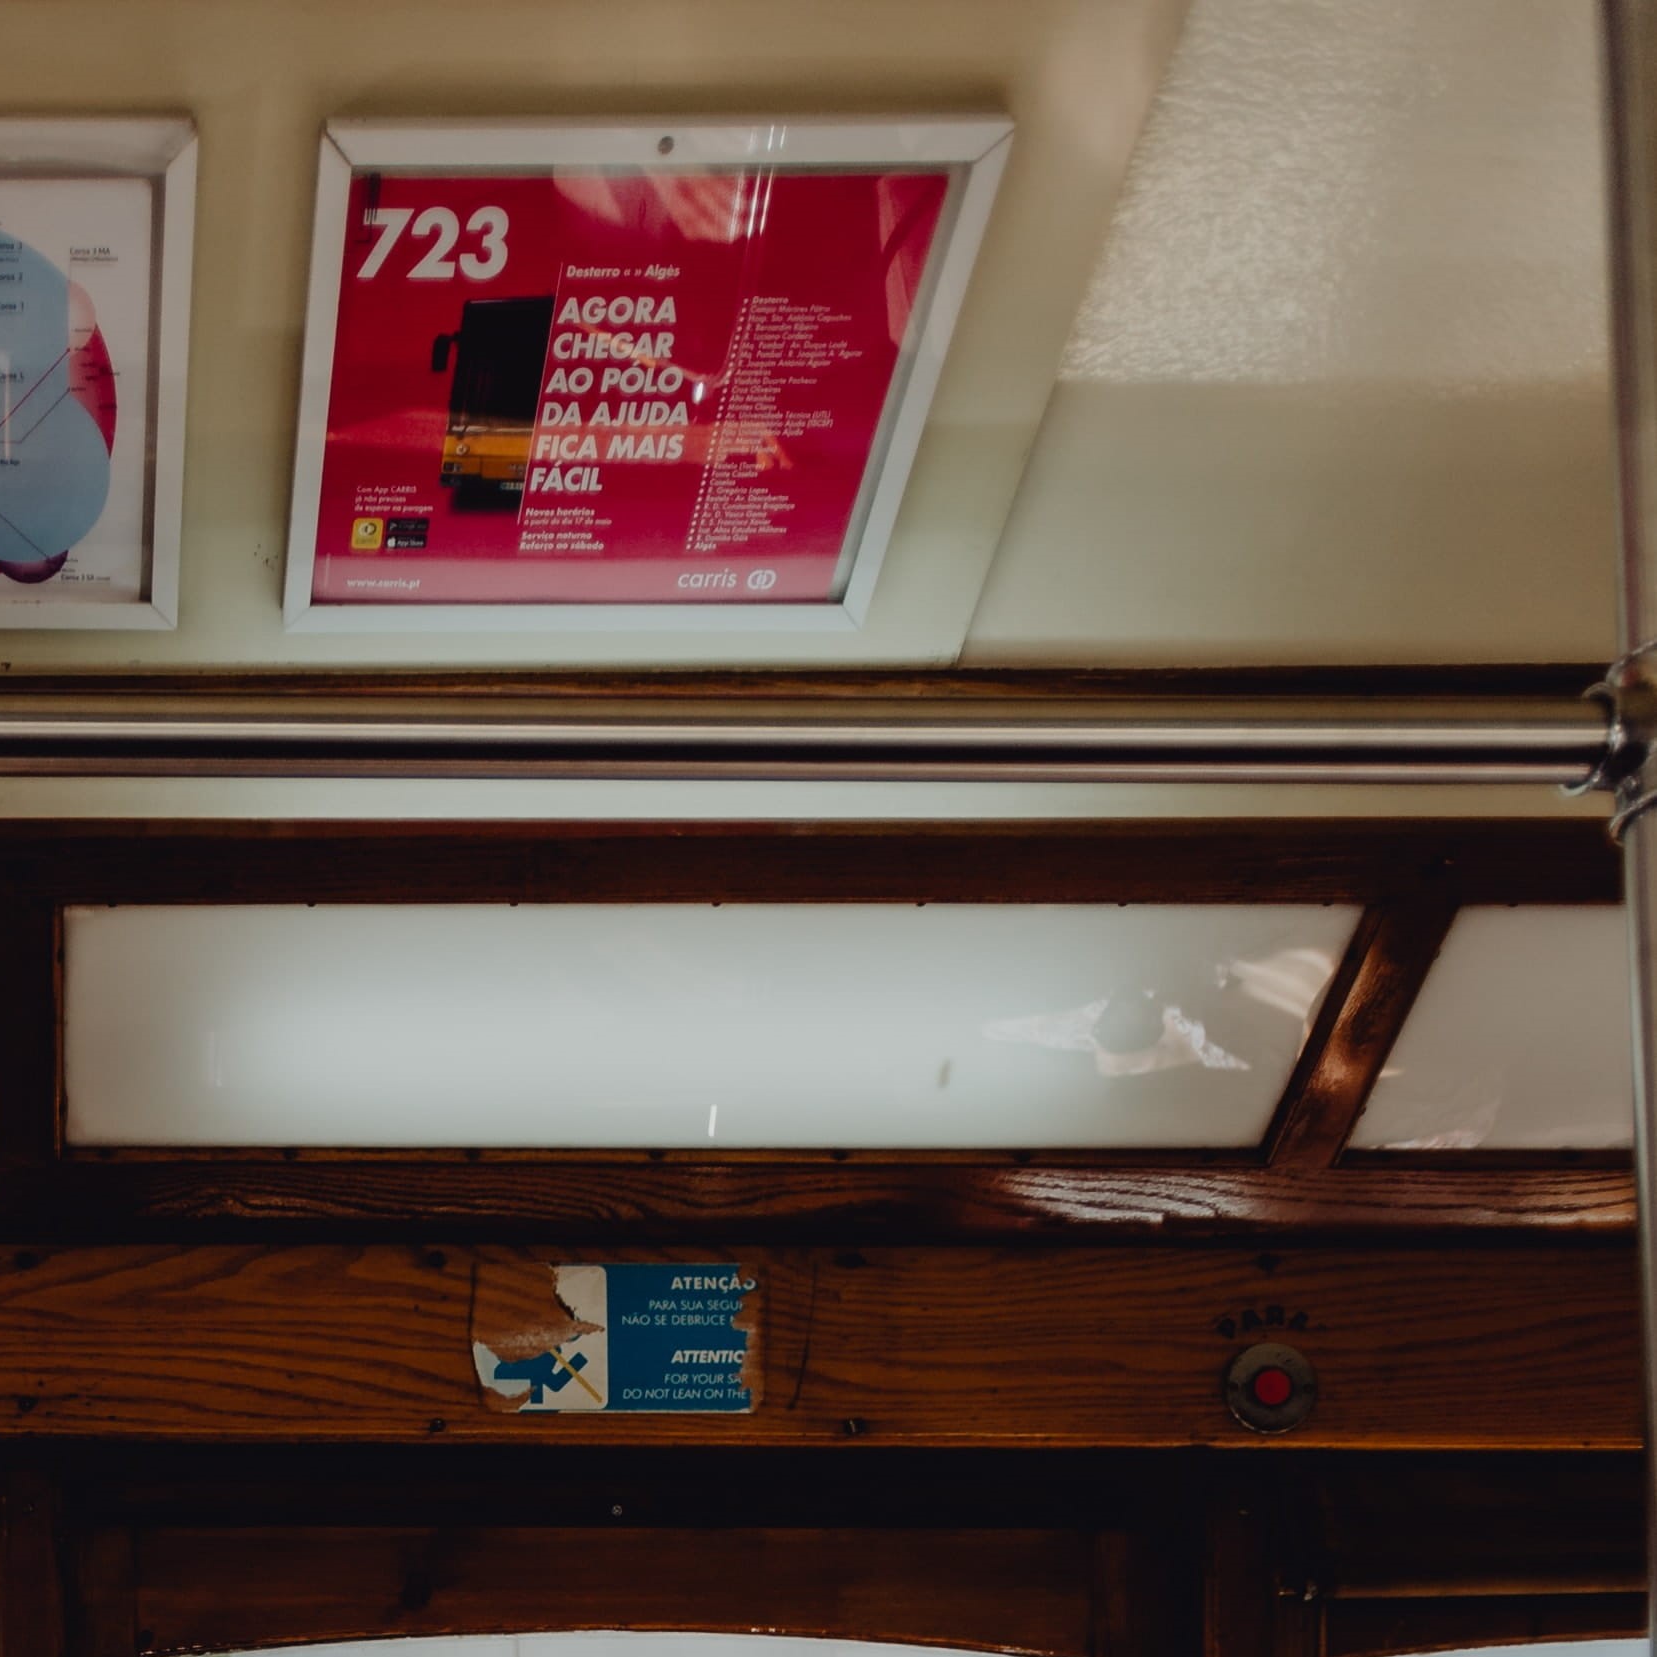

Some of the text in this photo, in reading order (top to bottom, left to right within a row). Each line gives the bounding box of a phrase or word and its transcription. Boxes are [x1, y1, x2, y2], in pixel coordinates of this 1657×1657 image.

[356, 205, 510, 280] 723
[566, 265, 620, 278] Desterro
[558, 296, 676, 324] AGORA
[553, 332, 674, 358] CHEGAR
[545, 361, 683, 393] AO PÓLO
[541, 402, 581, 426] DA
[589, 402, 688, 426] AJUDA
[535, 435, 684, 459] FICA MAIS
[530, 460, 602, 492] FÁCIL
[525, 507, 595, 516] Novos horários
[522, 532, 554, 542] Serviço
[347, 577, 420, 589] www.carris.pt
[678, 569, 737, 589] carris
[649, 1300, 676, 1311] PARA
[681, 1300, 704, 1311] SUA
[622, 1313, 726, 1326] NÃO SE DEBRUCE
[664, 1373, 688, 1384] FOR
[691, 1373, 725, 1384] YOUR
[623, 1388, 747, 1400] DO NOT LEAN ON THE
